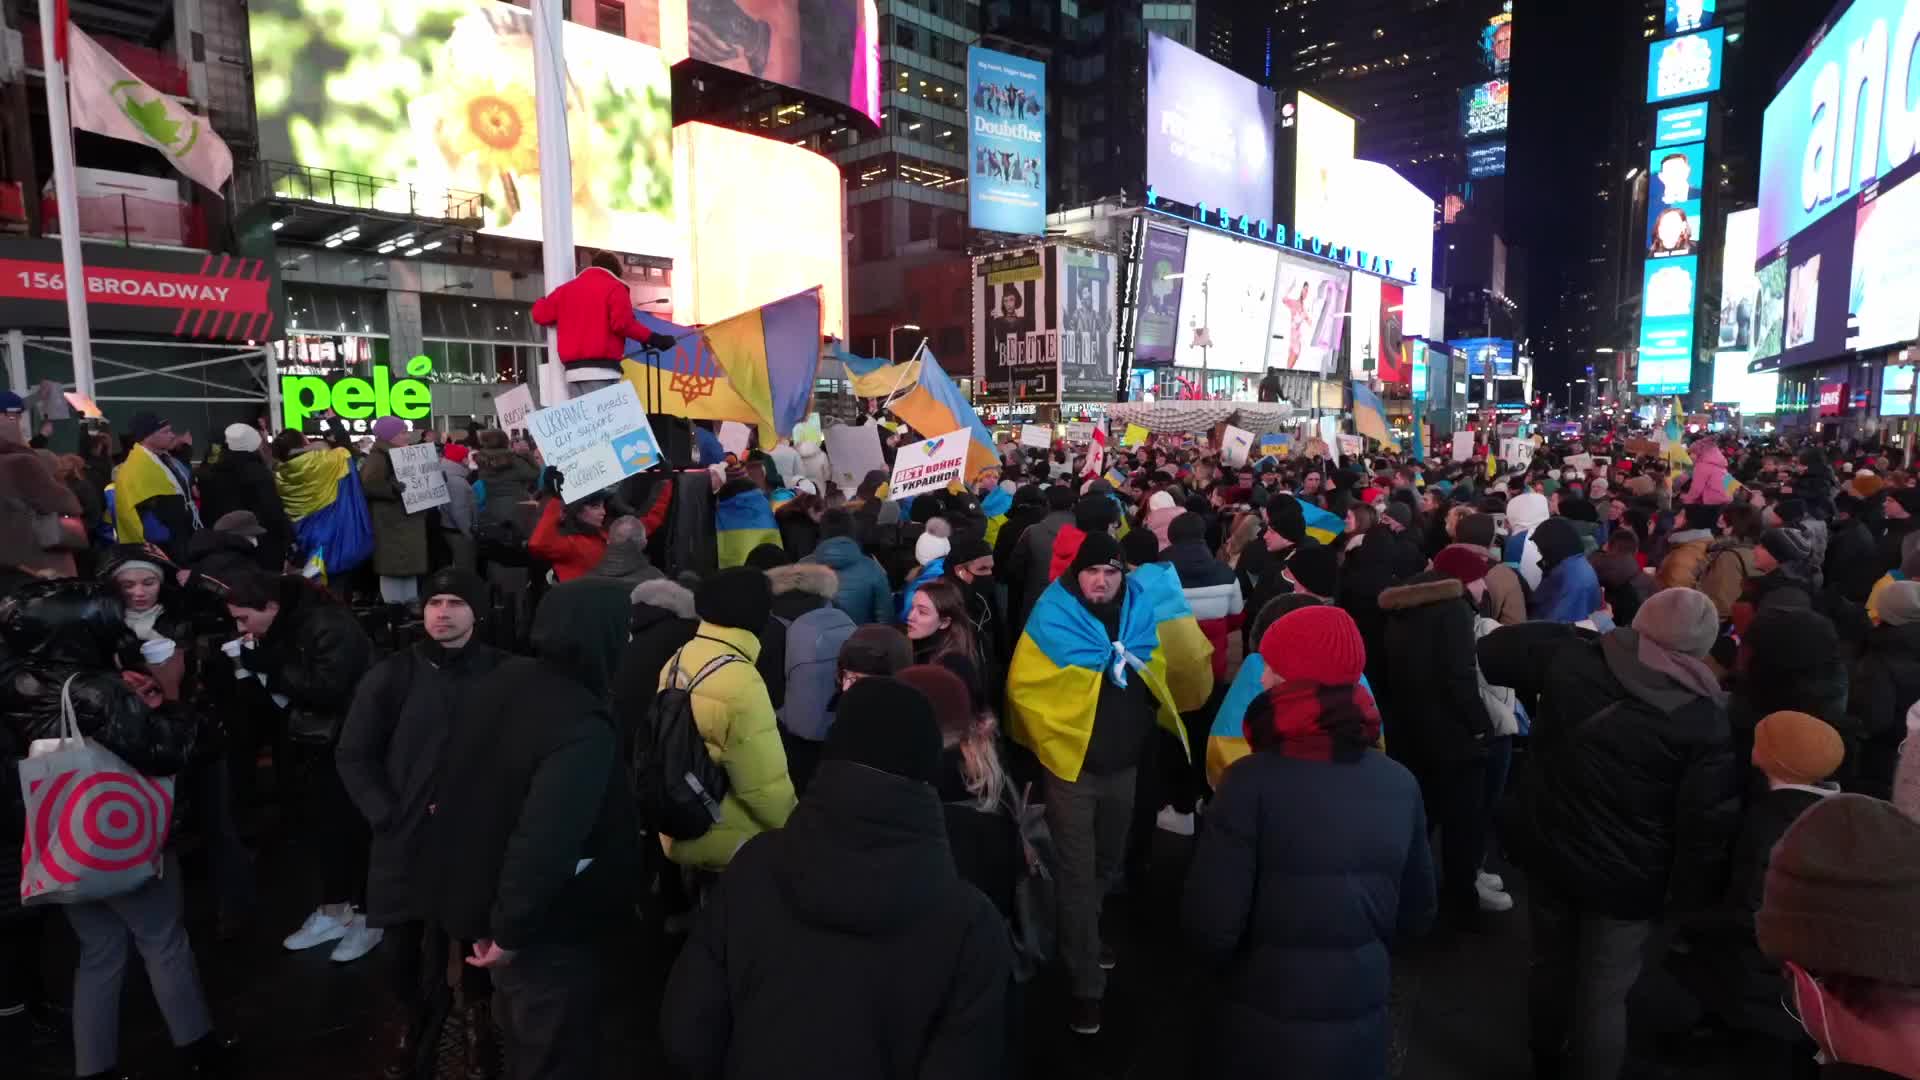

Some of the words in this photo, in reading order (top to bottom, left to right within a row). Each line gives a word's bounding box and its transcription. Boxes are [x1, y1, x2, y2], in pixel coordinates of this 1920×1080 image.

[975, 115, 1042, 144] Doubtfire
[1198, 201, 1268, 240] 1540
[1276, 224, 1394, 276] BROADWAY
[17, 271, 65, 291] 156
[87, 277, 229, 302] BROADWAY
[282, 355, 432, 432] pelé
[536, 400, 590, 439] UKRAINE
[597, 392, 629, 413] needs
[576, 412, 616, 437] support
[902, 468, 960, 492] УКРАИНОЙ
[925, 457, 963, 474] ВОЙНЕ
